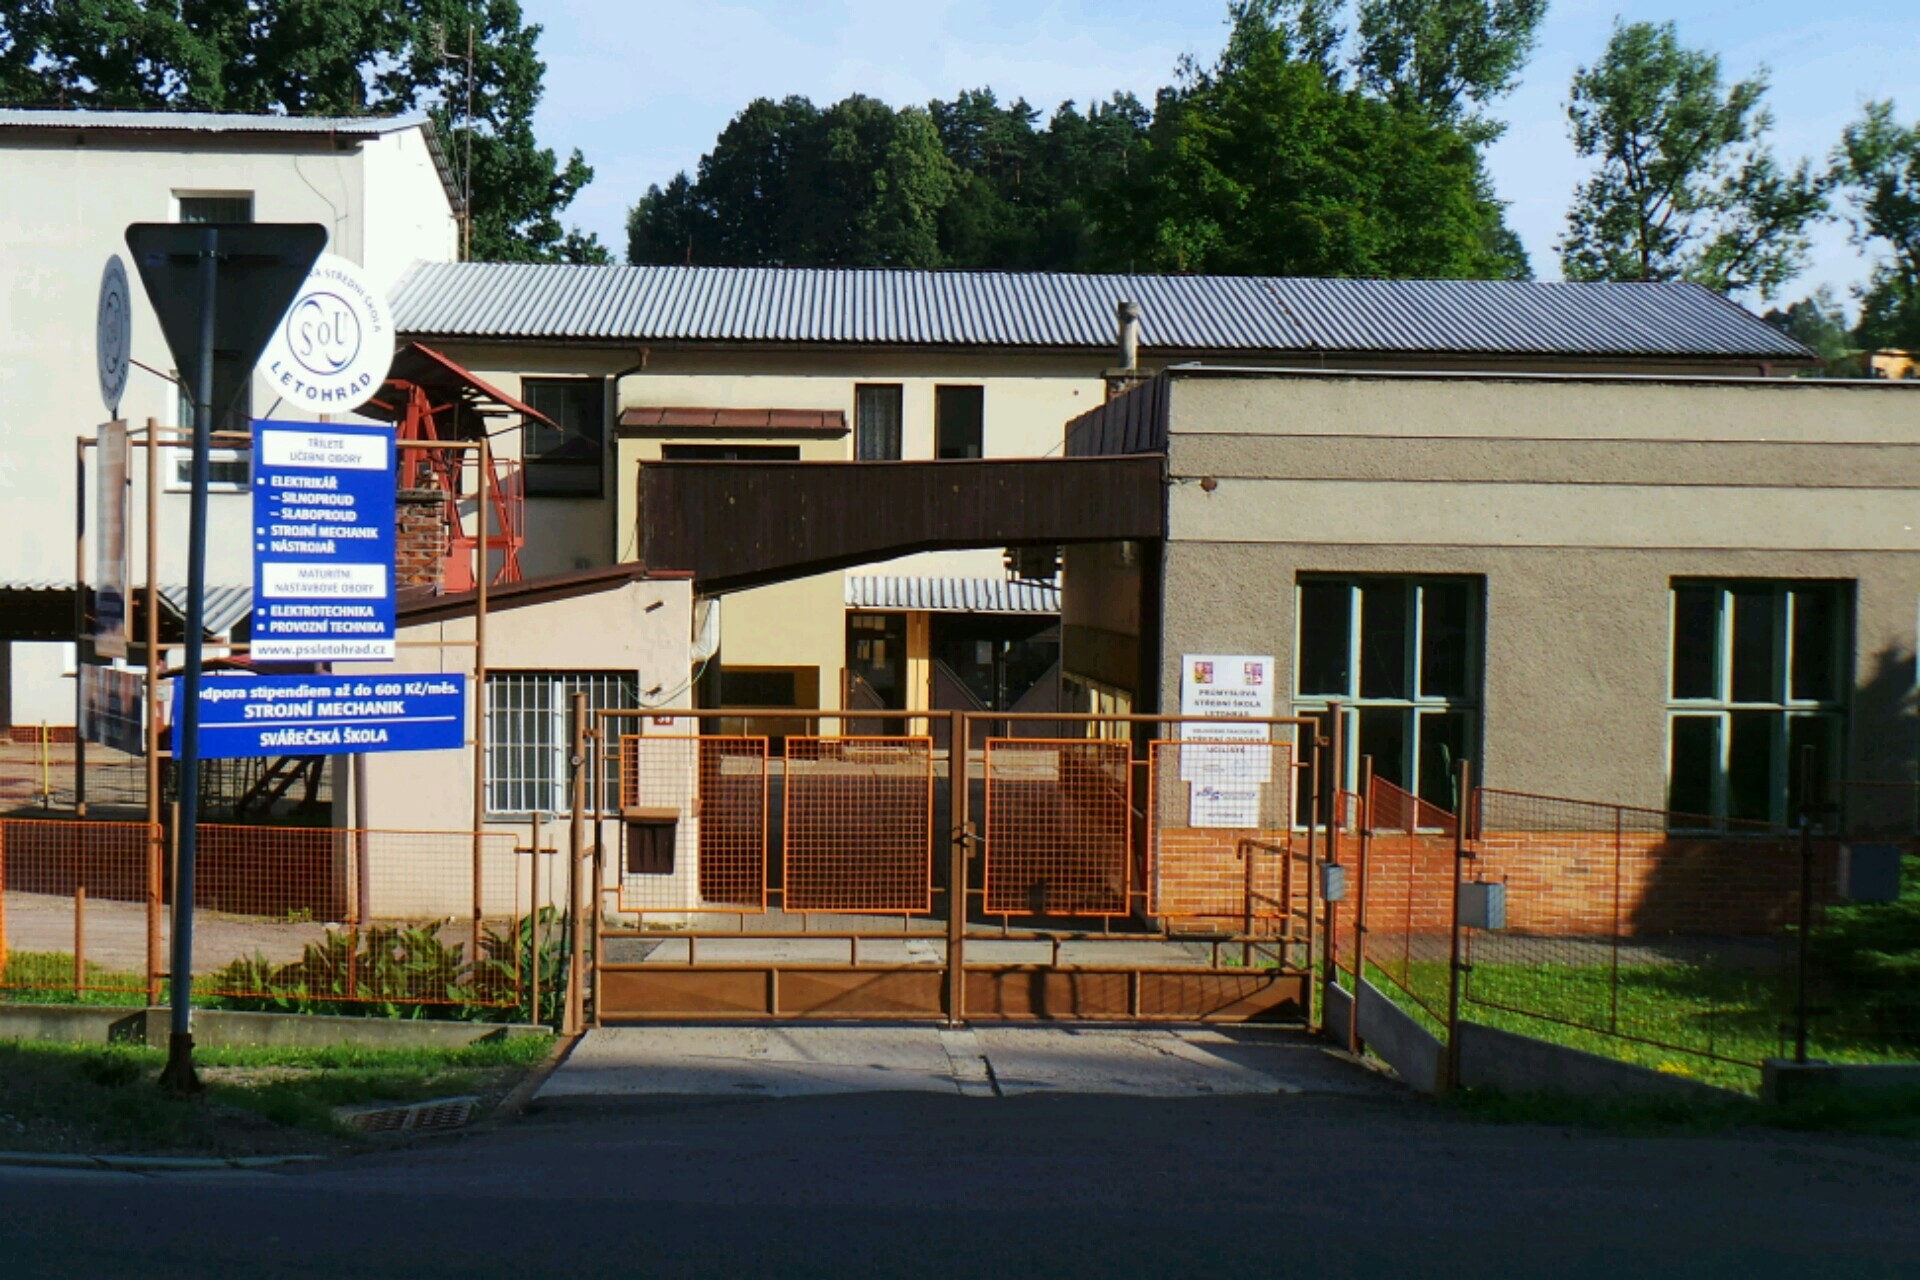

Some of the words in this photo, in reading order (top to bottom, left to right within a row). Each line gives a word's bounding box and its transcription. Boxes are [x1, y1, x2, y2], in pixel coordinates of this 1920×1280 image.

[270, 360, 371, 402] LETOHRAD
[281, 491, 355, 506] SILNOPROUD
[281, 507, 357, 522] SLABOPROUD
[270, 523, 317, 537] STROJNÍ
[318, 525, 379, 539] MECHANIK
[269, 604, 375, 617] ELEKTROTECHNIKA
[269, 618, 329, 633] PROVOZNÍ
[329, 621, 386, 633] TECHNIKA
[257, 643, 387, 657] www.pssletohrad.cz
[250, 684, 331, 701] stipendiem
[334, 683, 351, 697] až
[353, 683, 372, 696] do
[375, 682, 402, 696] 600
[404, 681, 459, 697] Kč/měs.
[244, 700, 314, 719] STROJNÍ
[317, 700, 406, 717] MECHANIK
[260, 727, 341, 747] SVÁŘEČSKÁ
[342, 727, 389, 744] ŠKOLA
